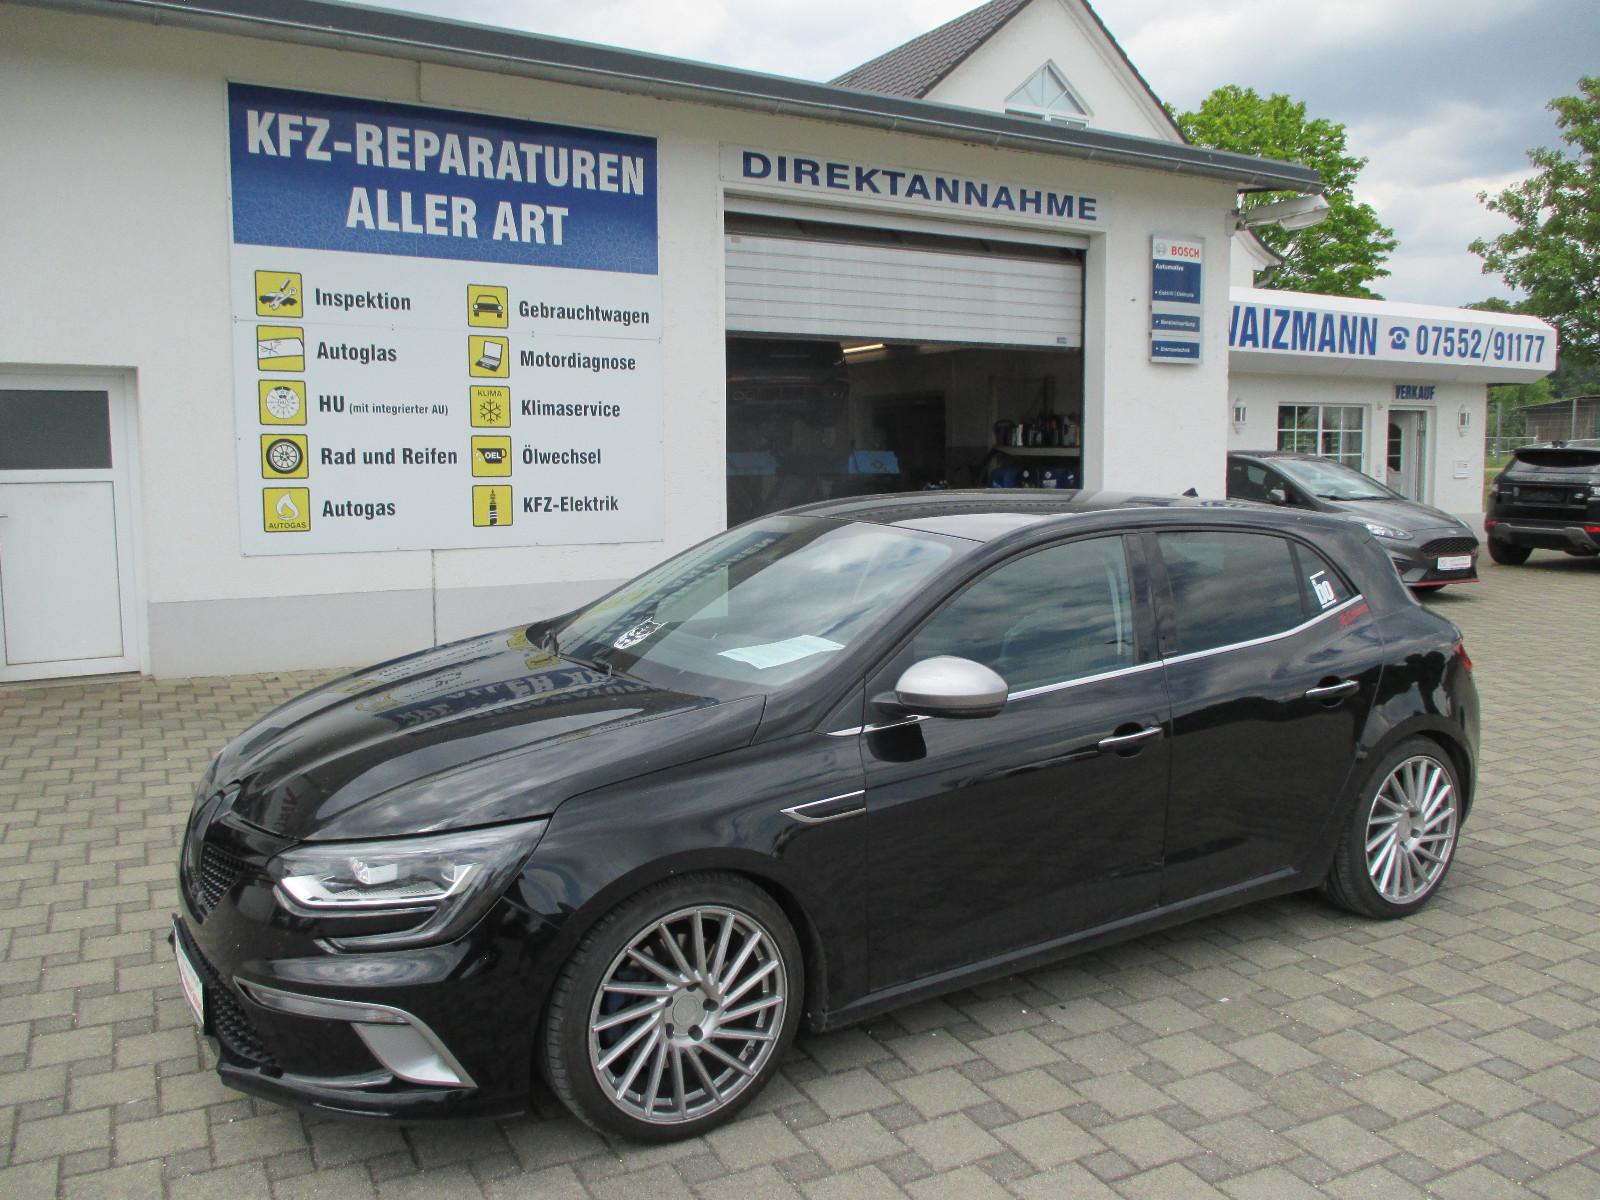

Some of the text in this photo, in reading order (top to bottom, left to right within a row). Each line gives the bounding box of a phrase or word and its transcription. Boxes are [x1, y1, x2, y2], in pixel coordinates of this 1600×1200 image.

[246, 109, 645, 196] KFZ-REPARATUREN
[742, 150, 1098, 222] DIREKTANNAHME
[345, 186, 569, 246] ALLER ART
[1171, 246, 1200, 258] BOSCH
[315, 287, 411, 311] Inspektion
[519, 300, 650, 326] Gebrauchtwagen
[316, 341, 397, 364] Autoglas
[1416, 324, 1545, 363] 07552/91177
[520, 350, 636, 372] Motordiagnose
[477, 389, 503, 397] KLIMA
[1394, 384, 1436, 400] VERKAUF
[319, 395, 449, 416] HU (mit integrierter AU)
[521, 399, 621, 418] Klimaservice
[321, 447, 458, 465] Rad und Reifen
[485, 451, 502, 459] OEL
[522, 444, 601, 464] Ölwechsel
[322, 500, 396, 520] Autogas
[523, 496, 619, 513] KFZ-Elektrik
[268, 521, 307, 530] AUTOGAS
